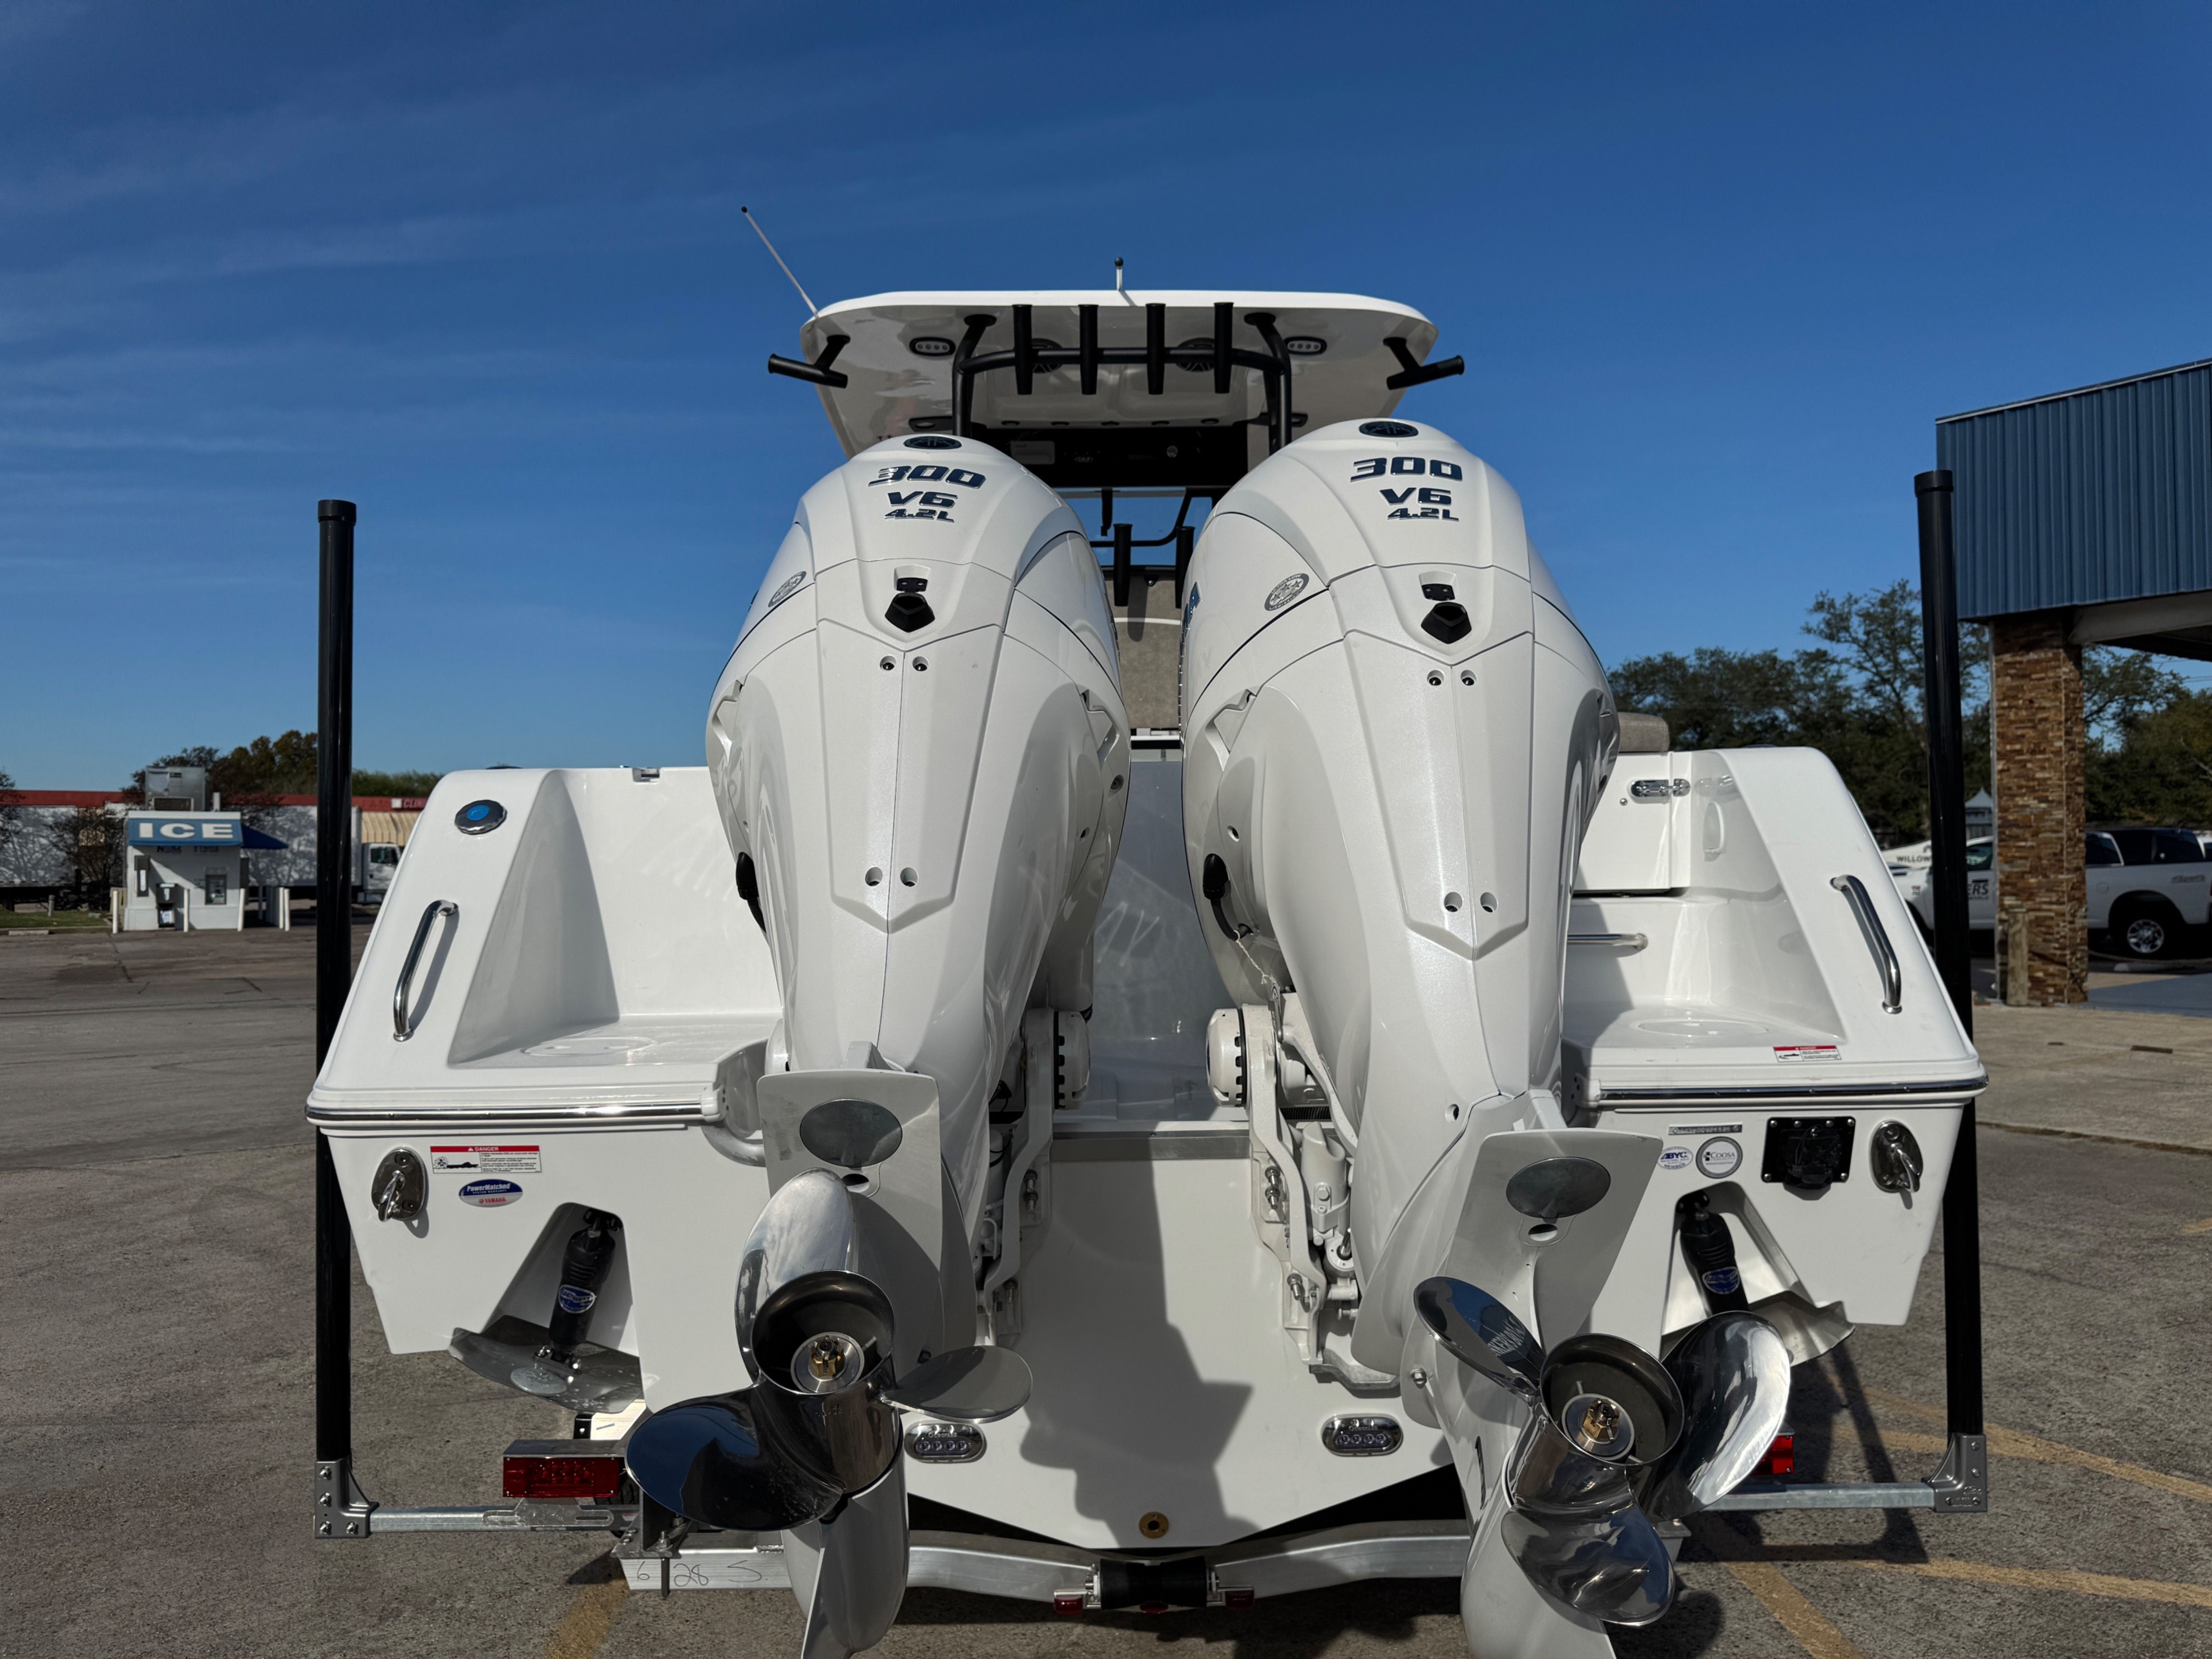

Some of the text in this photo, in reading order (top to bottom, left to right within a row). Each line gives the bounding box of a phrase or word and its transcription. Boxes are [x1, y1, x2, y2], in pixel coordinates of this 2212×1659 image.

[868, 465, 986, 489] 300
[1350, 456, 1462, 482] 300
[887, 491, 958, 508] V6
[1380, 487, 1452, 506] V6
[884, 508, 955, 523] 4.2L
[1387, 507, 1459, 523] 4.2L
[139, 822, 233, 839] ICE
